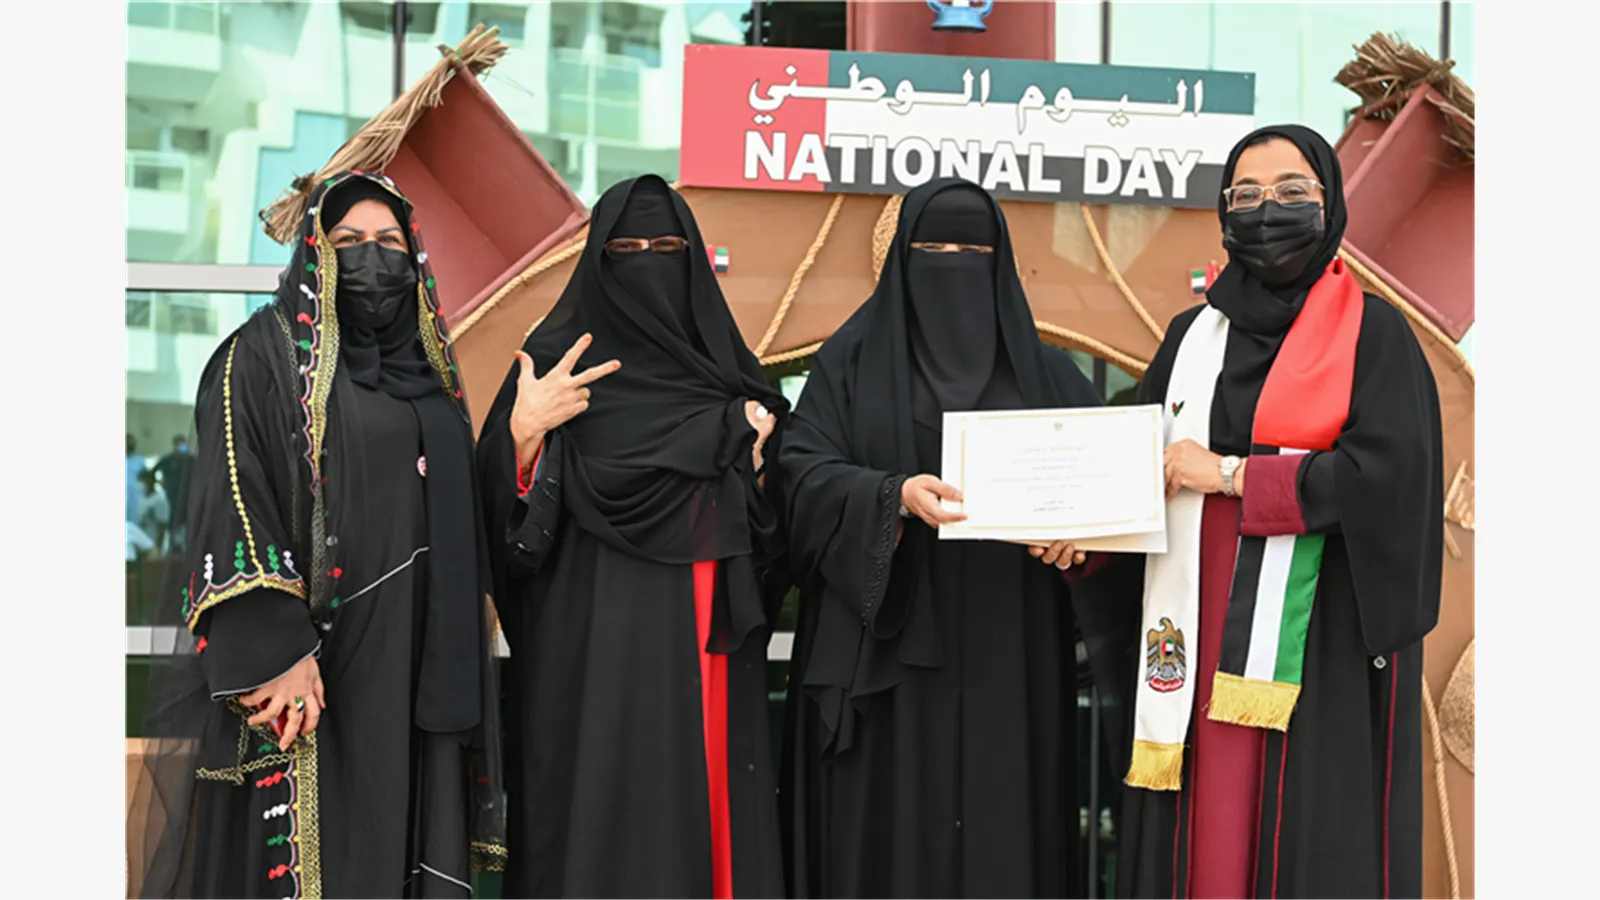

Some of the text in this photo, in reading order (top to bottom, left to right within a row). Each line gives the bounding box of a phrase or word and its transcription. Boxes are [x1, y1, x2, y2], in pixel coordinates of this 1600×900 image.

[748, 61, 1203, 134] اليوم الوطني
[743, 130, 1203, 199] NATIONAL DAY
